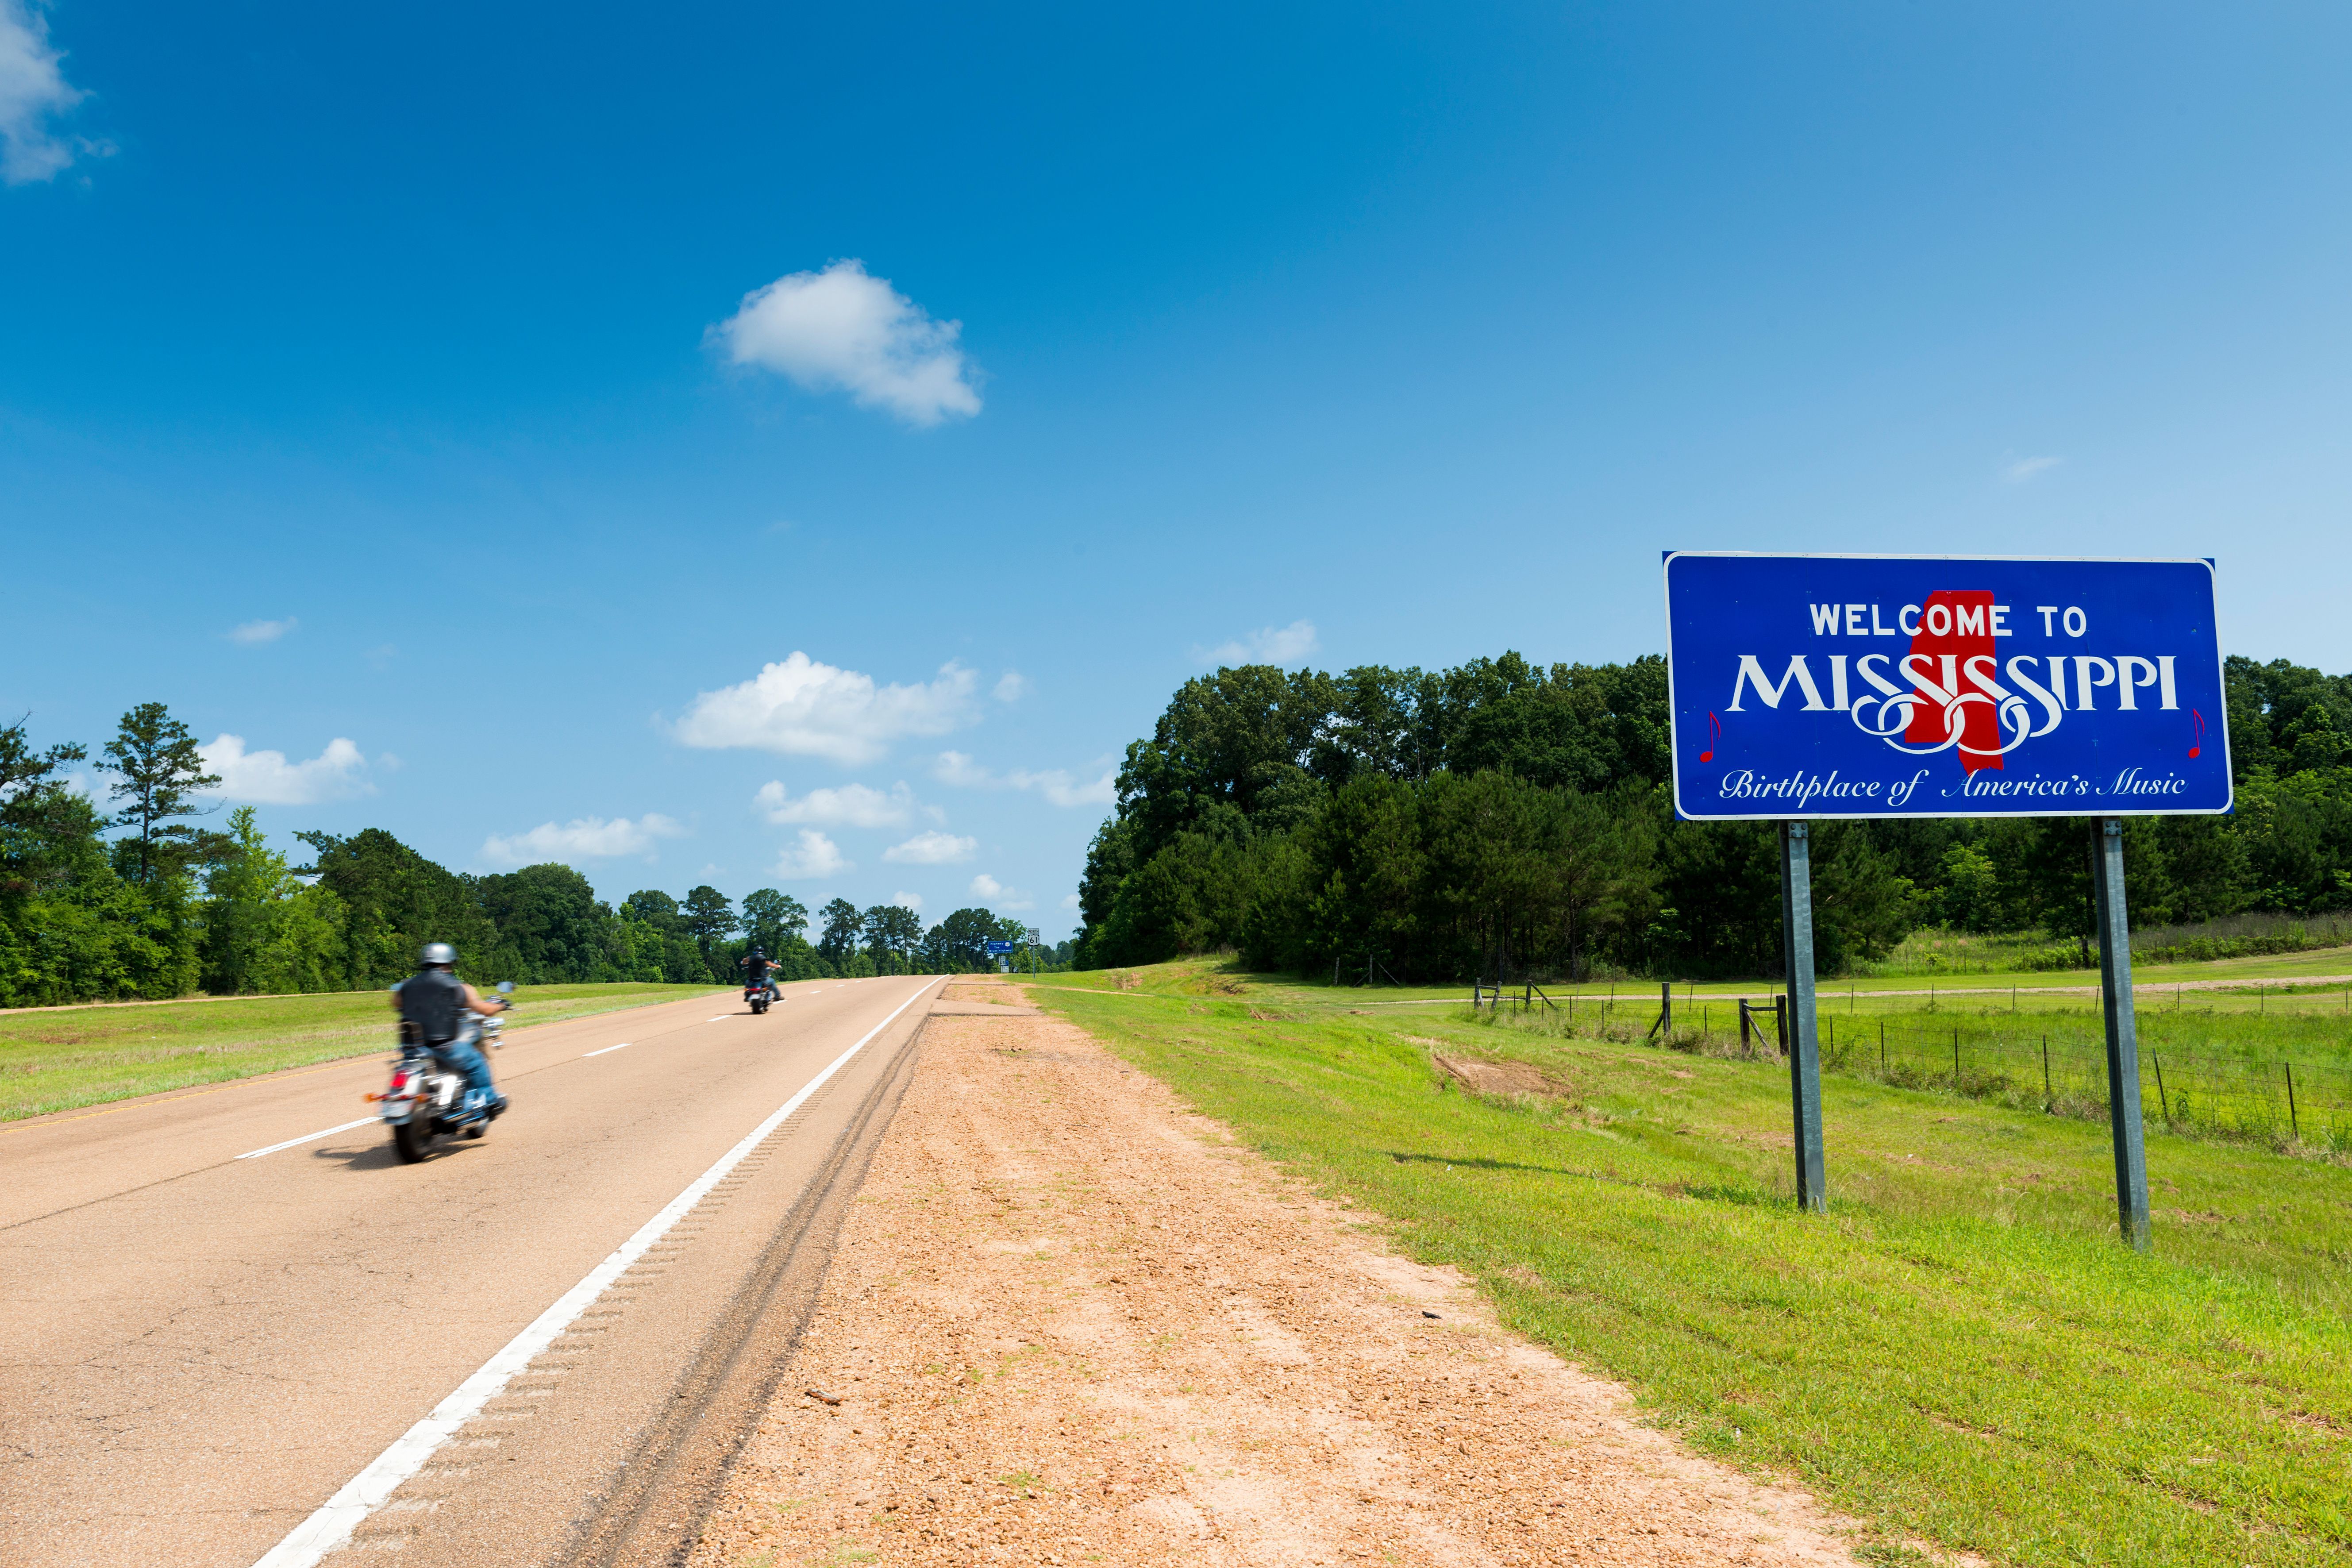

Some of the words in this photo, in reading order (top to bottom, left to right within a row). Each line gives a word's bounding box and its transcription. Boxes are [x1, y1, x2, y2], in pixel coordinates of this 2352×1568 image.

[1809, 604, 2013, 636] WELCOME
[2036, 606, 2087, 638] TO
[1724, 654, 2180, 755] MISSISSIPPI
[1719, 769, 1884, 808] Birthplace
[1887, 769, 1929, 806] of
[1941, 769, 2094, 797] America's
[2095, 767, 2189, 795] Music
